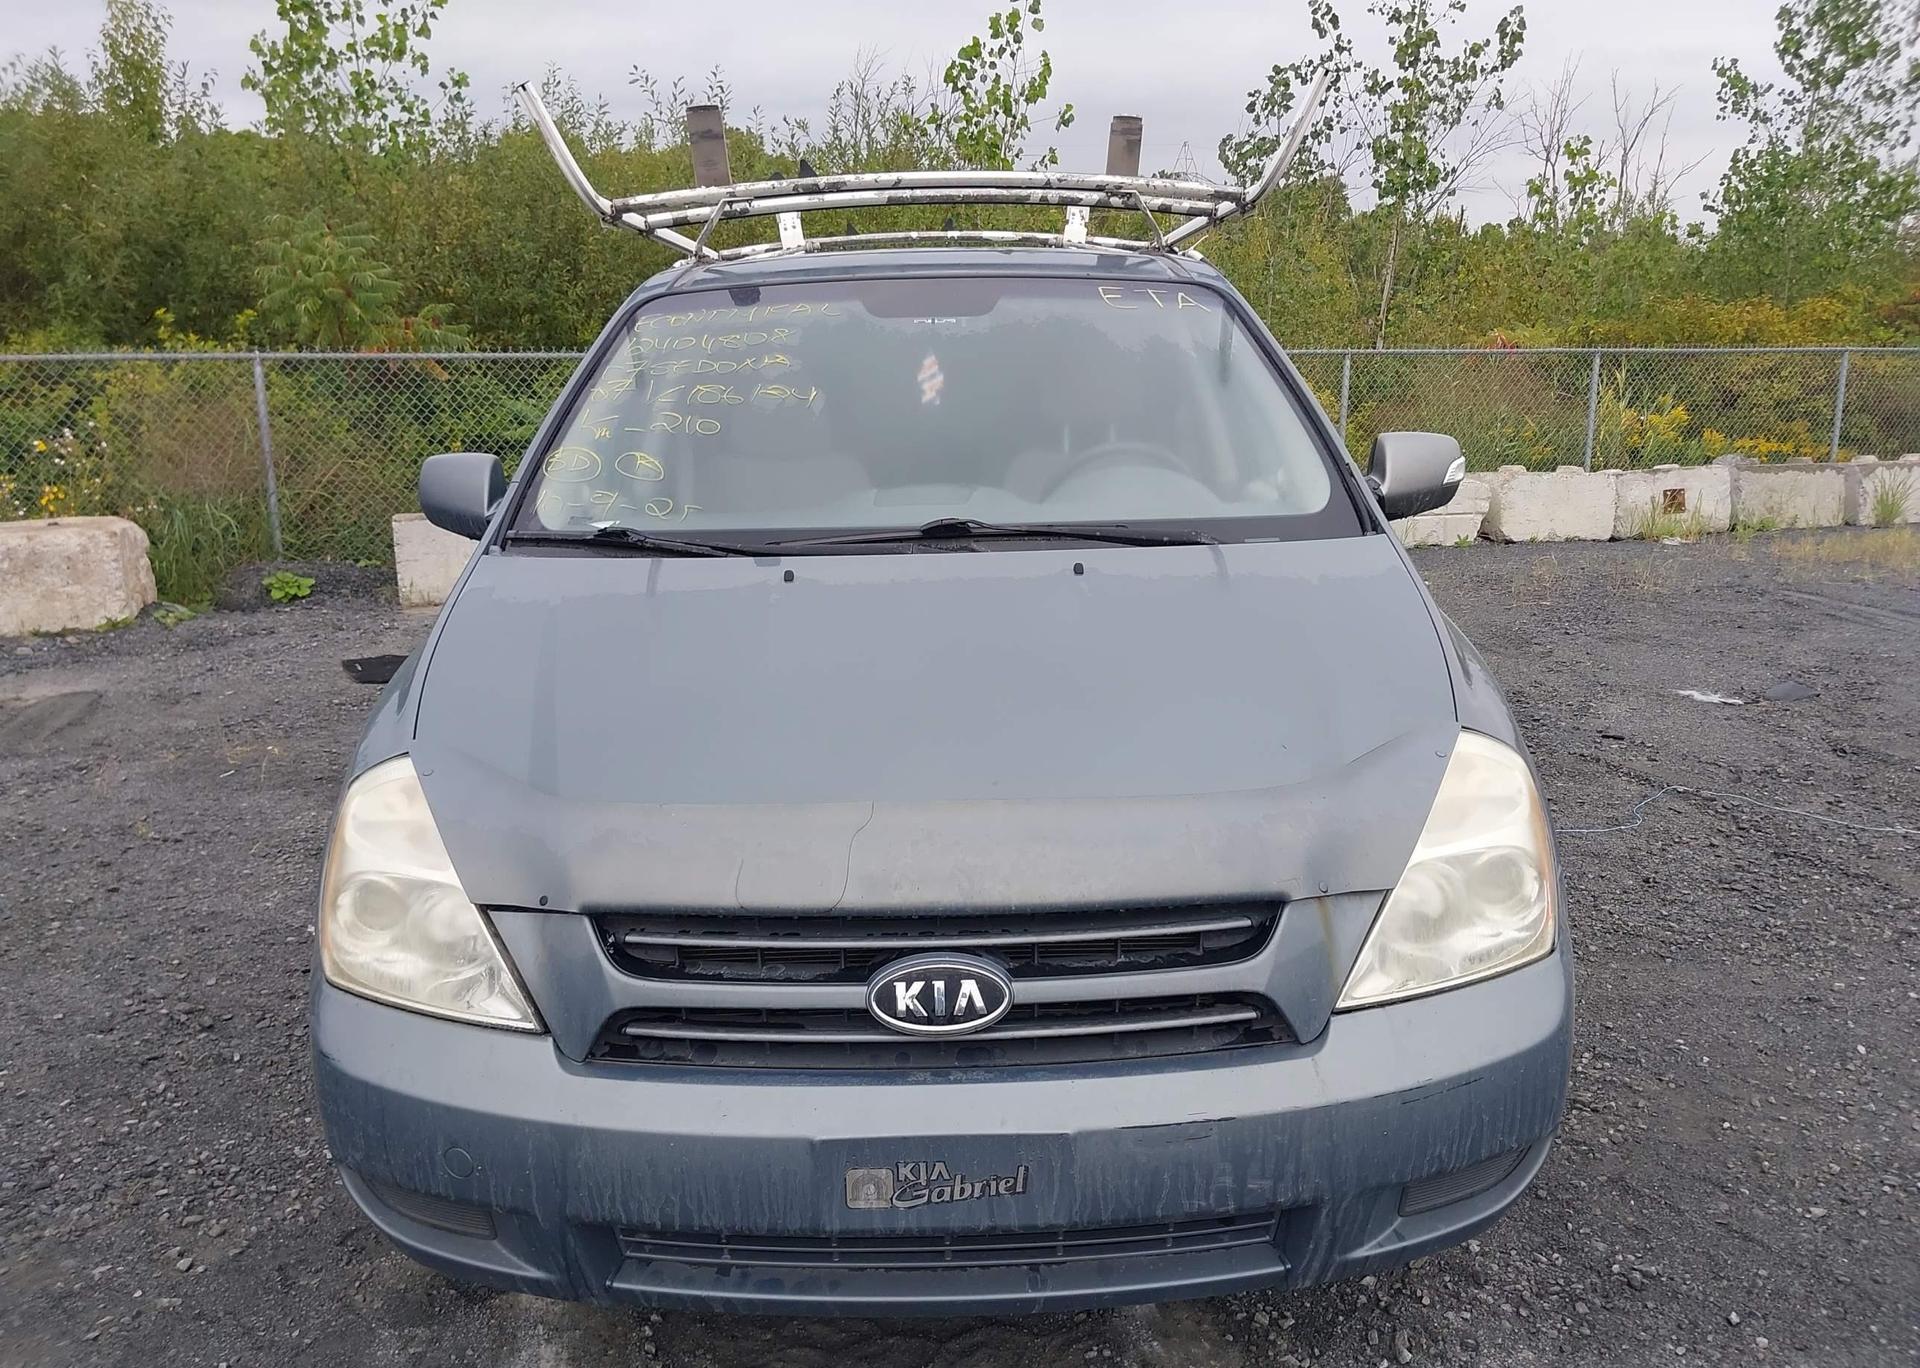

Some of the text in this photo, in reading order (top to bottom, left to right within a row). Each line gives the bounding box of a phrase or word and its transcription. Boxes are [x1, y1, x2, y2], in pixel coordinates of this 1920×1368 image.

[1097, 285, 1213, 313] ETA
[893, 979, 988, 1018] KIA
[892, 1165, 1029, 1208] Gabriel
[897, 1161, 952, 1185] KIA
